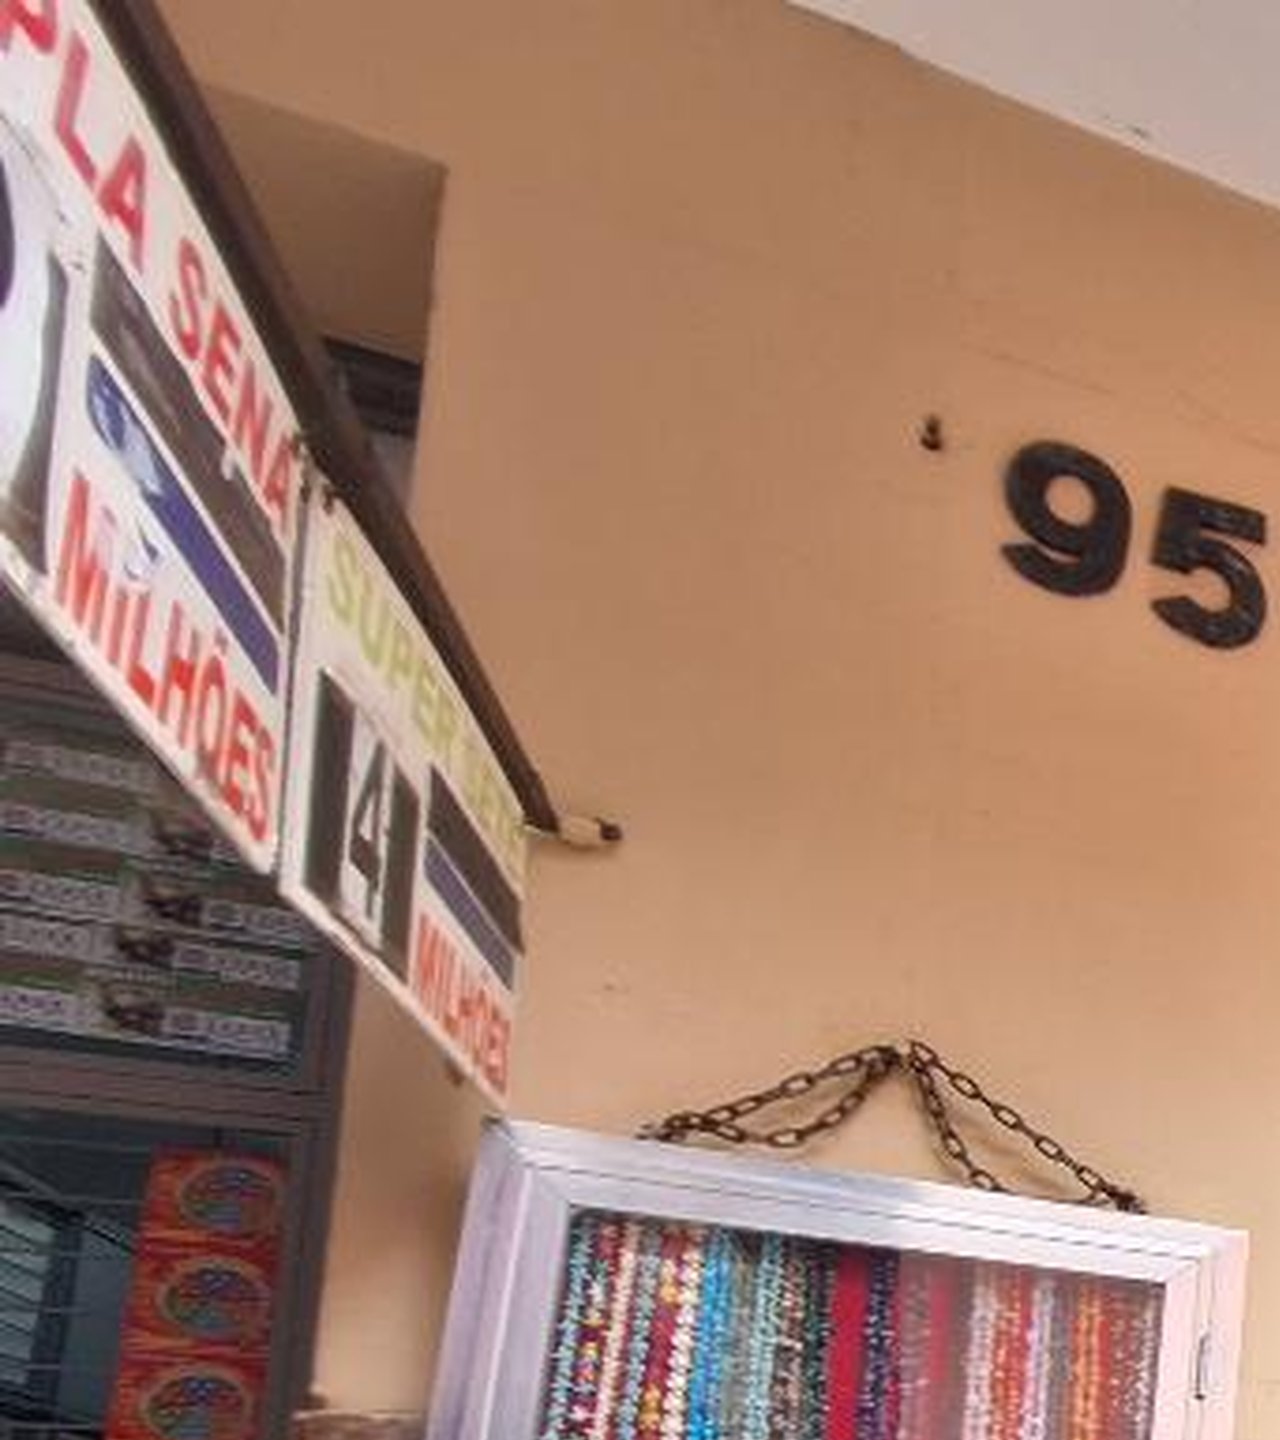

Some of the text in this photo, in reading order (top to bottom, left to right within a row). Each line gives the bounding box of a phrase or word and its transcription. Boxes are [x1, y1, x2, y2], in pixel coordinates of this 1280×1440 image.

[169, 236, 300, 536] SENA
[327, 531, 460, 757] SUPER
[1000, 439, 1268, 650] 95
